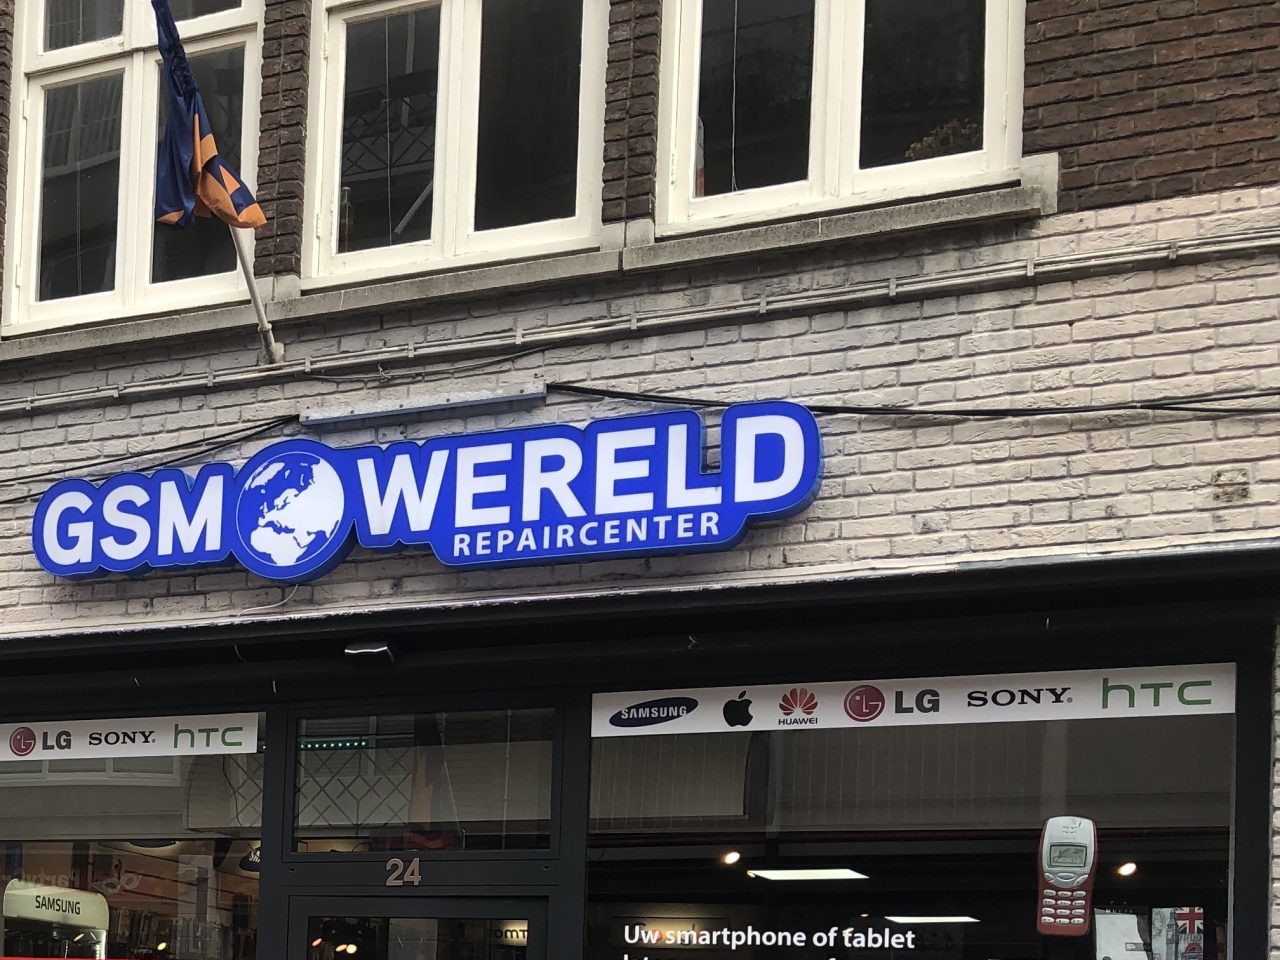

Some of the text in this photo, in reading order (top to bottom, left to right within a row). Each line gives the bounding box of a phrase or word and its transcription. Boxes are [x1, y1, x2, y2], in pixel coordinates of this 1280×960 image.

[43, 415, 806, 565] GSM WERELD
[453, 512, 720, 557] REPAIRCENTER
[894, 690, 940, 713] LG
[966, 687, 1072, 708] SONY
[621, 705, 687, 719] SAMSUNG
[778, 717, 818, 726] HUAWEI
[42, 731, 72, 750] LG
[88, 731, 155, 746] SONY
[385, 857, 422, 886] 24
[35, 895, 81, 915] SAMSUNG
[624, 925, 916, 950] Uw smartphone of tablet
